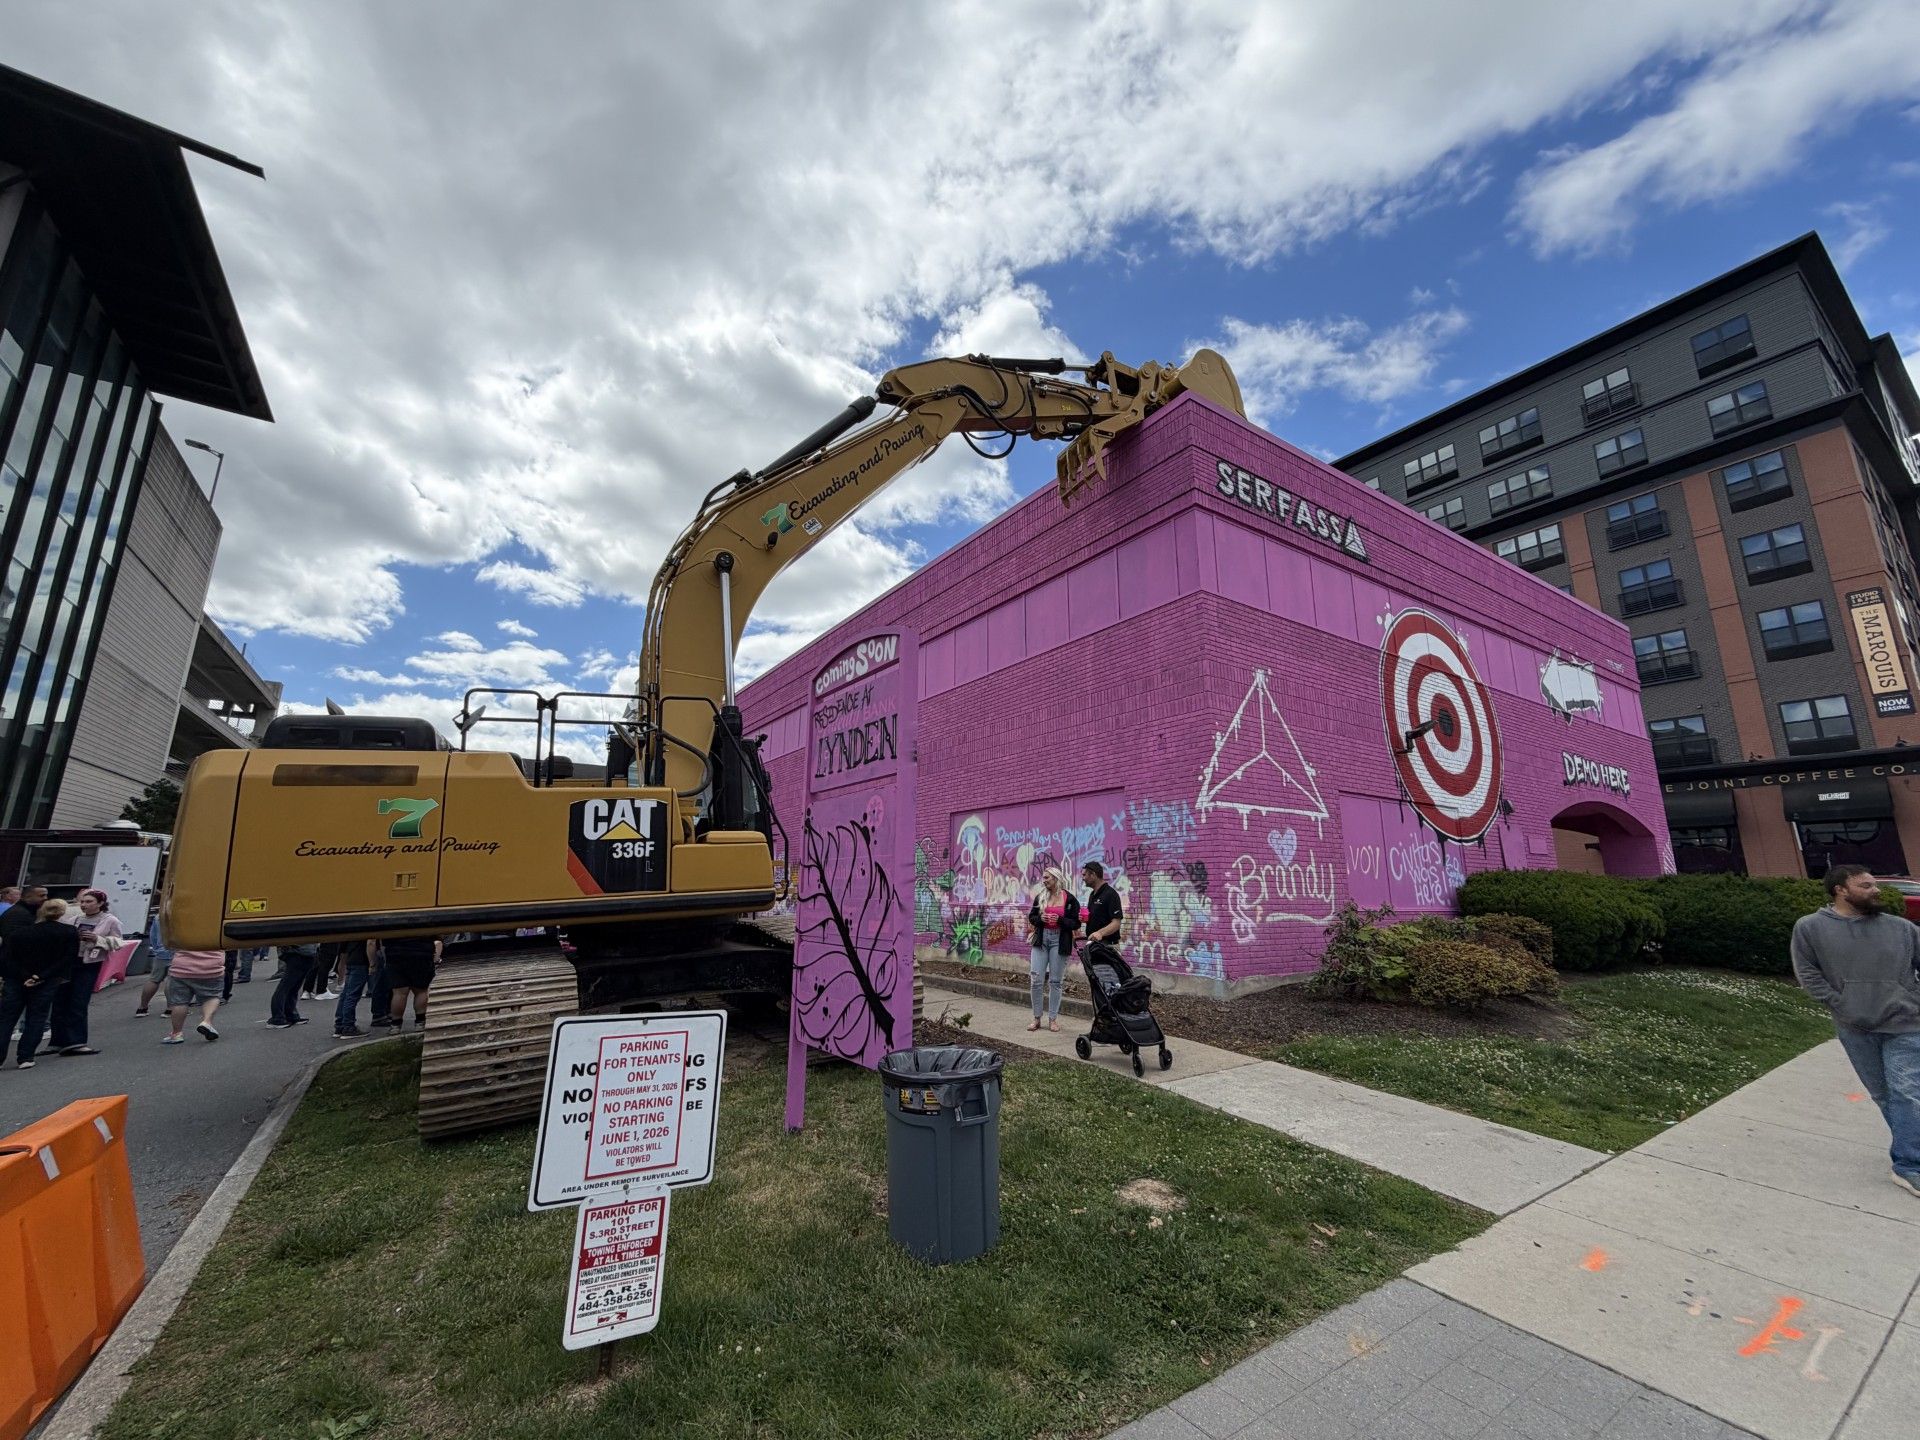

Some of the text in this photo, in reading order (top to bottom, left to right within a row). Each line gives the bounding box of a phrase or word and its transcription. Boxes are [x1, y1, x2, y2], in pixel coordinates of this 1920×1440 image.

[788, 424, 925, 521] Excavating and Paving
[760, 503, 796, 535] 7
[1850, 590, 1879, 599] STUDIO
[1862, 615, 1898, 688] MARQUIS
[1878, 697, 1909, 708] NOW
[1880, 704, 1911, 713] LEASING
[814, 713, 898, 778] LYNDEN
[1563, 752, 1631, 795] DEMO HERE
[1686, 777, 1748, 791] JOINT
[1762, 769, 1856, 785] COFFEE
[1873, 765, 1918, 776] CO.
[378, 797, 440, 839] 7
[583, 799, 658, 841] CAT
[295, 837, 501, 859] Excavating and Paving
[612, 841, 655, 859] 336F
[1231, 849, 1336, 924] Brandy
[620, 1039, 669, 1053] PARKING
[604, 1053, 681, 1070] FOR TENANTS
[627, 1070, 657, 1083] ONLY
[562, 1088, 593, 1105] NO
[602, 1087, 635, 1098] THROUGH
[636, 1085, 651, 1094] MAY
[661, 1082, 678, 1091] 2026
[603, 1095, 673, 1114] NO PARKING
[685, 1100, 703, 1111] BE
[608, 1111, 665, 1129] STARTING
[600, 1131, 631, 1146] JUNE
[633, 1130, 640, 1142] 1,
[643, 1126, 670, 1140] 2026
[605, 1142, 663, 1158] VIOLATORS WILL
[615, 1154, 651, 1167] BE TOWED
[561, 1185, 582, 1194] AREA
[583, 1181, 610, 1191] UNDER
[611, 1176, 640, 1186] REMOTE
[590, 1202, 658, 1221] PARKING FOR
[611, 1216, 630, 1226] 101
[620, 1220, 655, 1233] STREET
[607, 1233, 631, 1243] ONLY
[587, 1238, 653, 1258] TOWING ENFORCED
[593, 1249, 645, 1266] AT ALL TIMES
[580, 1265, 616, 1278] UNAUTHORIZED
[618, 1260, 639, 1270] VEHICLES
[640, 1258, 650, 1266] WILL
[638, 1265, 656, 1275] EXPENSE
[578, 1288, 653, 1311] 484-358-6256
